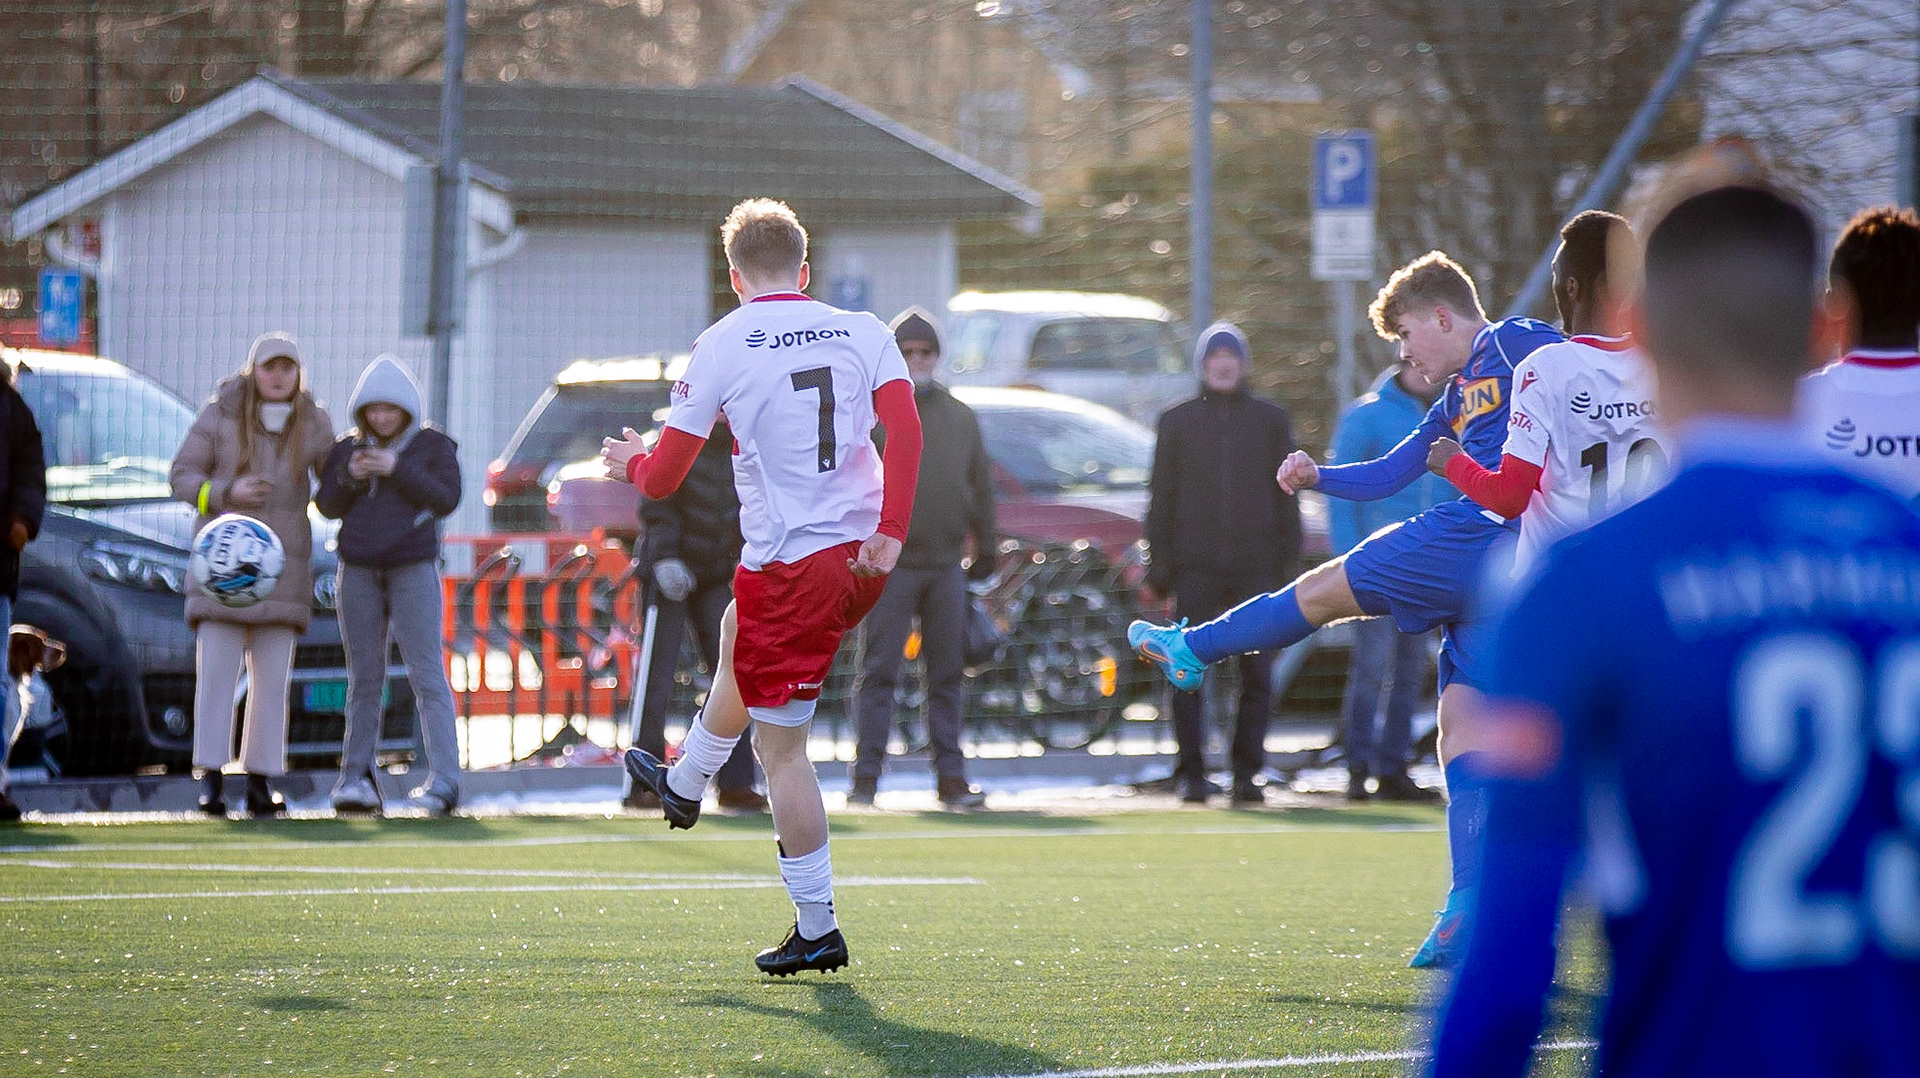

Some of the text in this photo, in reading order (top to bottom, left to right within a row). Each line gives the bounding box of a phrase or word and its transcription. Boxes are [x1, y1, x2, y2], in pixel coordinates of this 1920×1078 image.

[1326, 140, 1364, 203] P
[769, 329, 850, 349] JOTRON
[790, 366, 836, 473] 7
[1589, 400, 1659, 420] JOTRO
[1854, 434, 1920, 457] JOT
